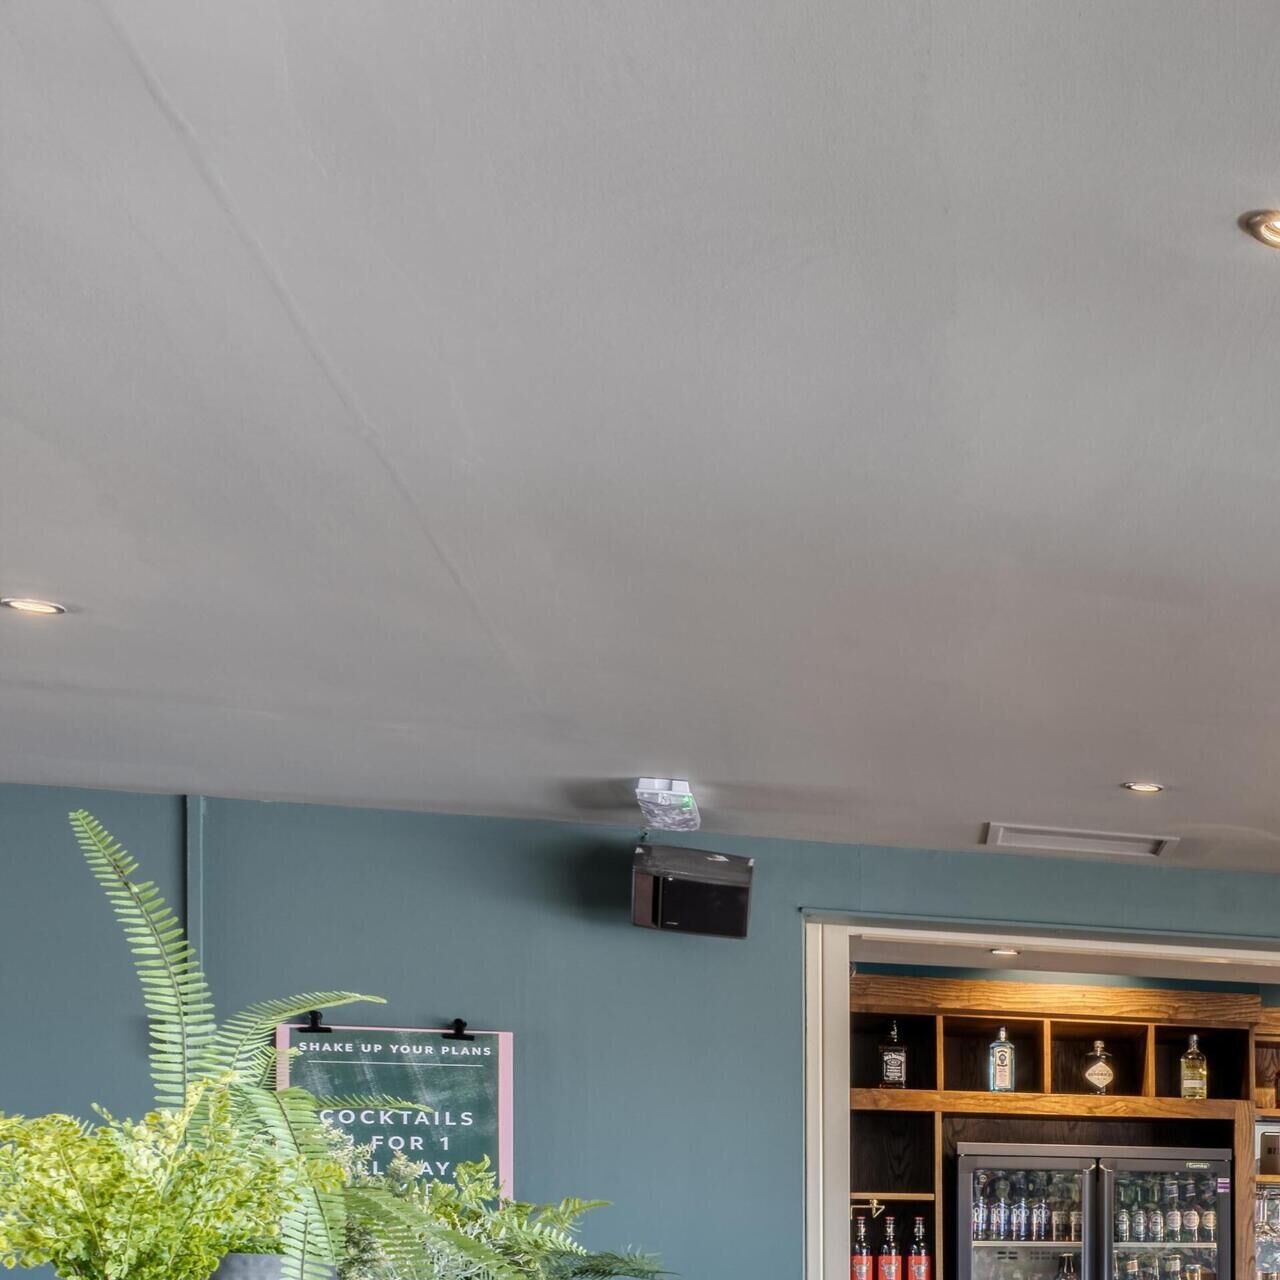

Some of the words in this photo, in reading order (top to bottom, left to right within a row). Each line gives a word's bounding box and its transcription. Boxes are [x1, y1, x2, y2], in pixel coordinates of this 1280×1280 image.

[299, 1042, 354, 1053] SHAKE
[361, 1043, 383, 1053] UP
[390, 1044, 435, 1055] YOUR
[441, 1046, 492, 1056] PLANS
[319, 1109, 474, 1127] COCKTAILS
[372, 1135, 425, 1151] FOR
[440, 1136, 450, 1151] 1
